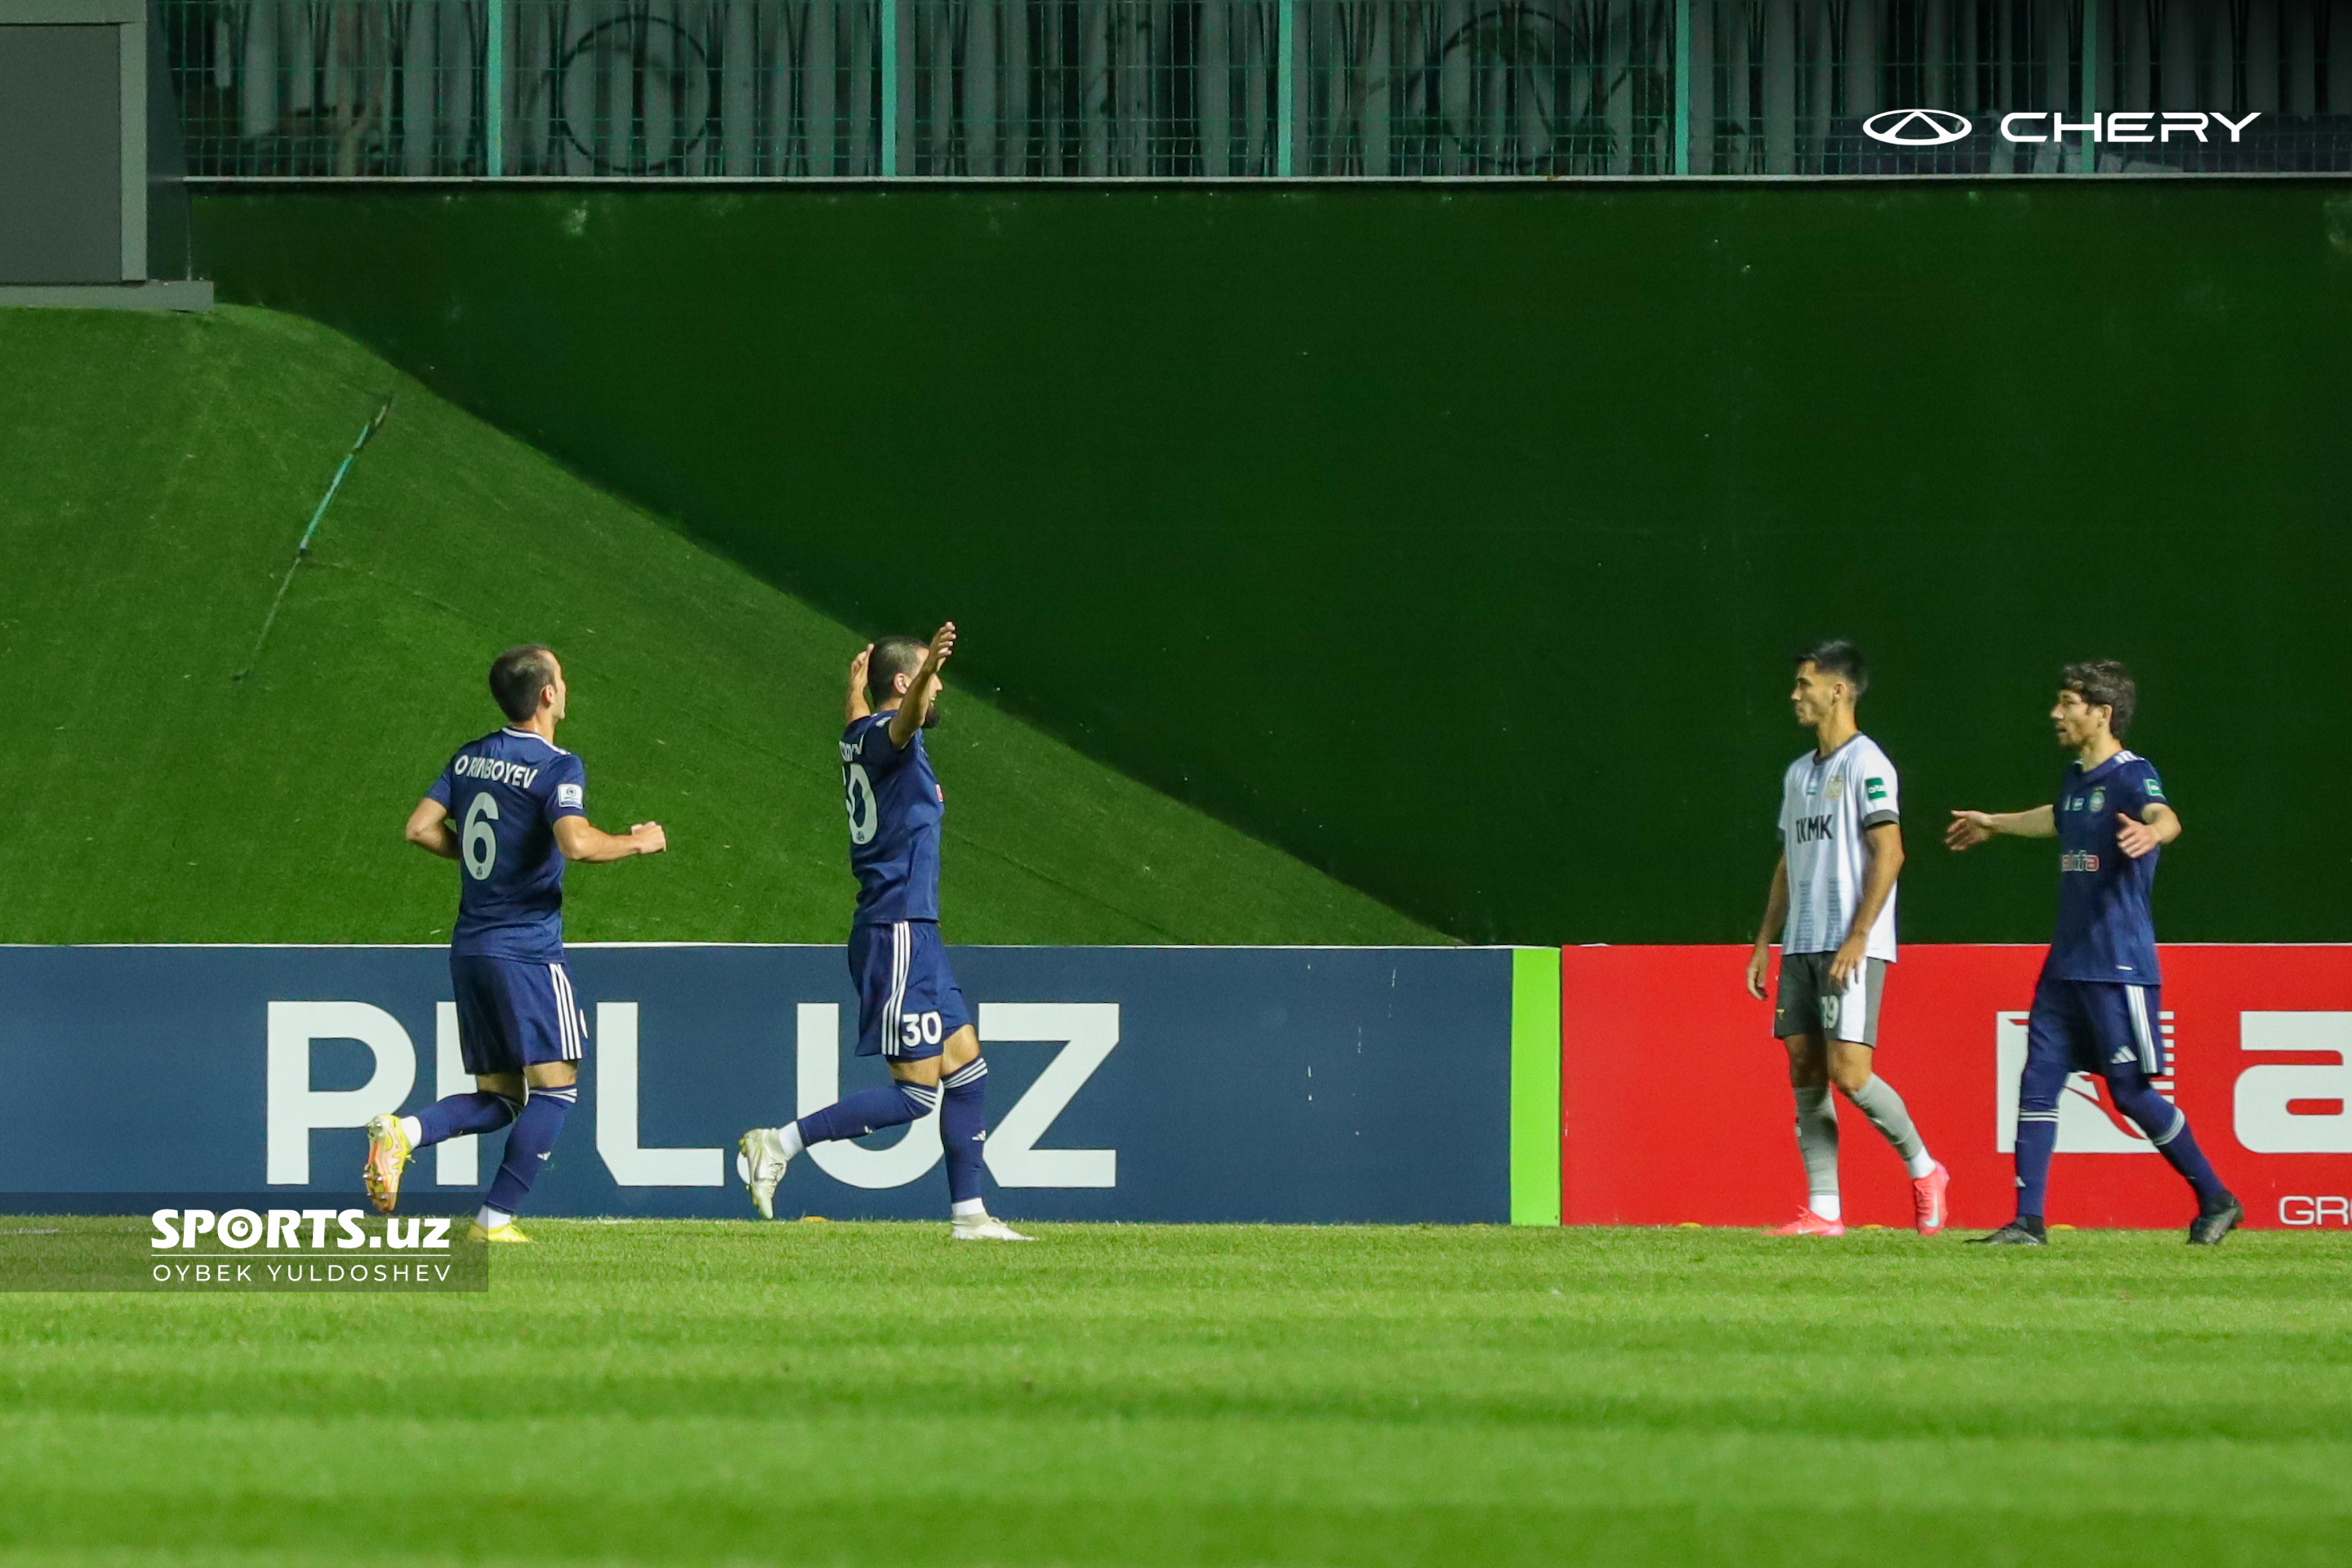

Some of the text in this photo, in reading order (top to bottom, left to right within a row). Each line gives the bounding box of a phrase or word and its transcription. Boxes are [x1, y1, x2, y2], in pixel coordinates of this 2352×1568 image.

[462, 792, 499, 880] 6
[902, 1011, 942, 1047] 30
[2279, 1196, 2352, 1225] GR
